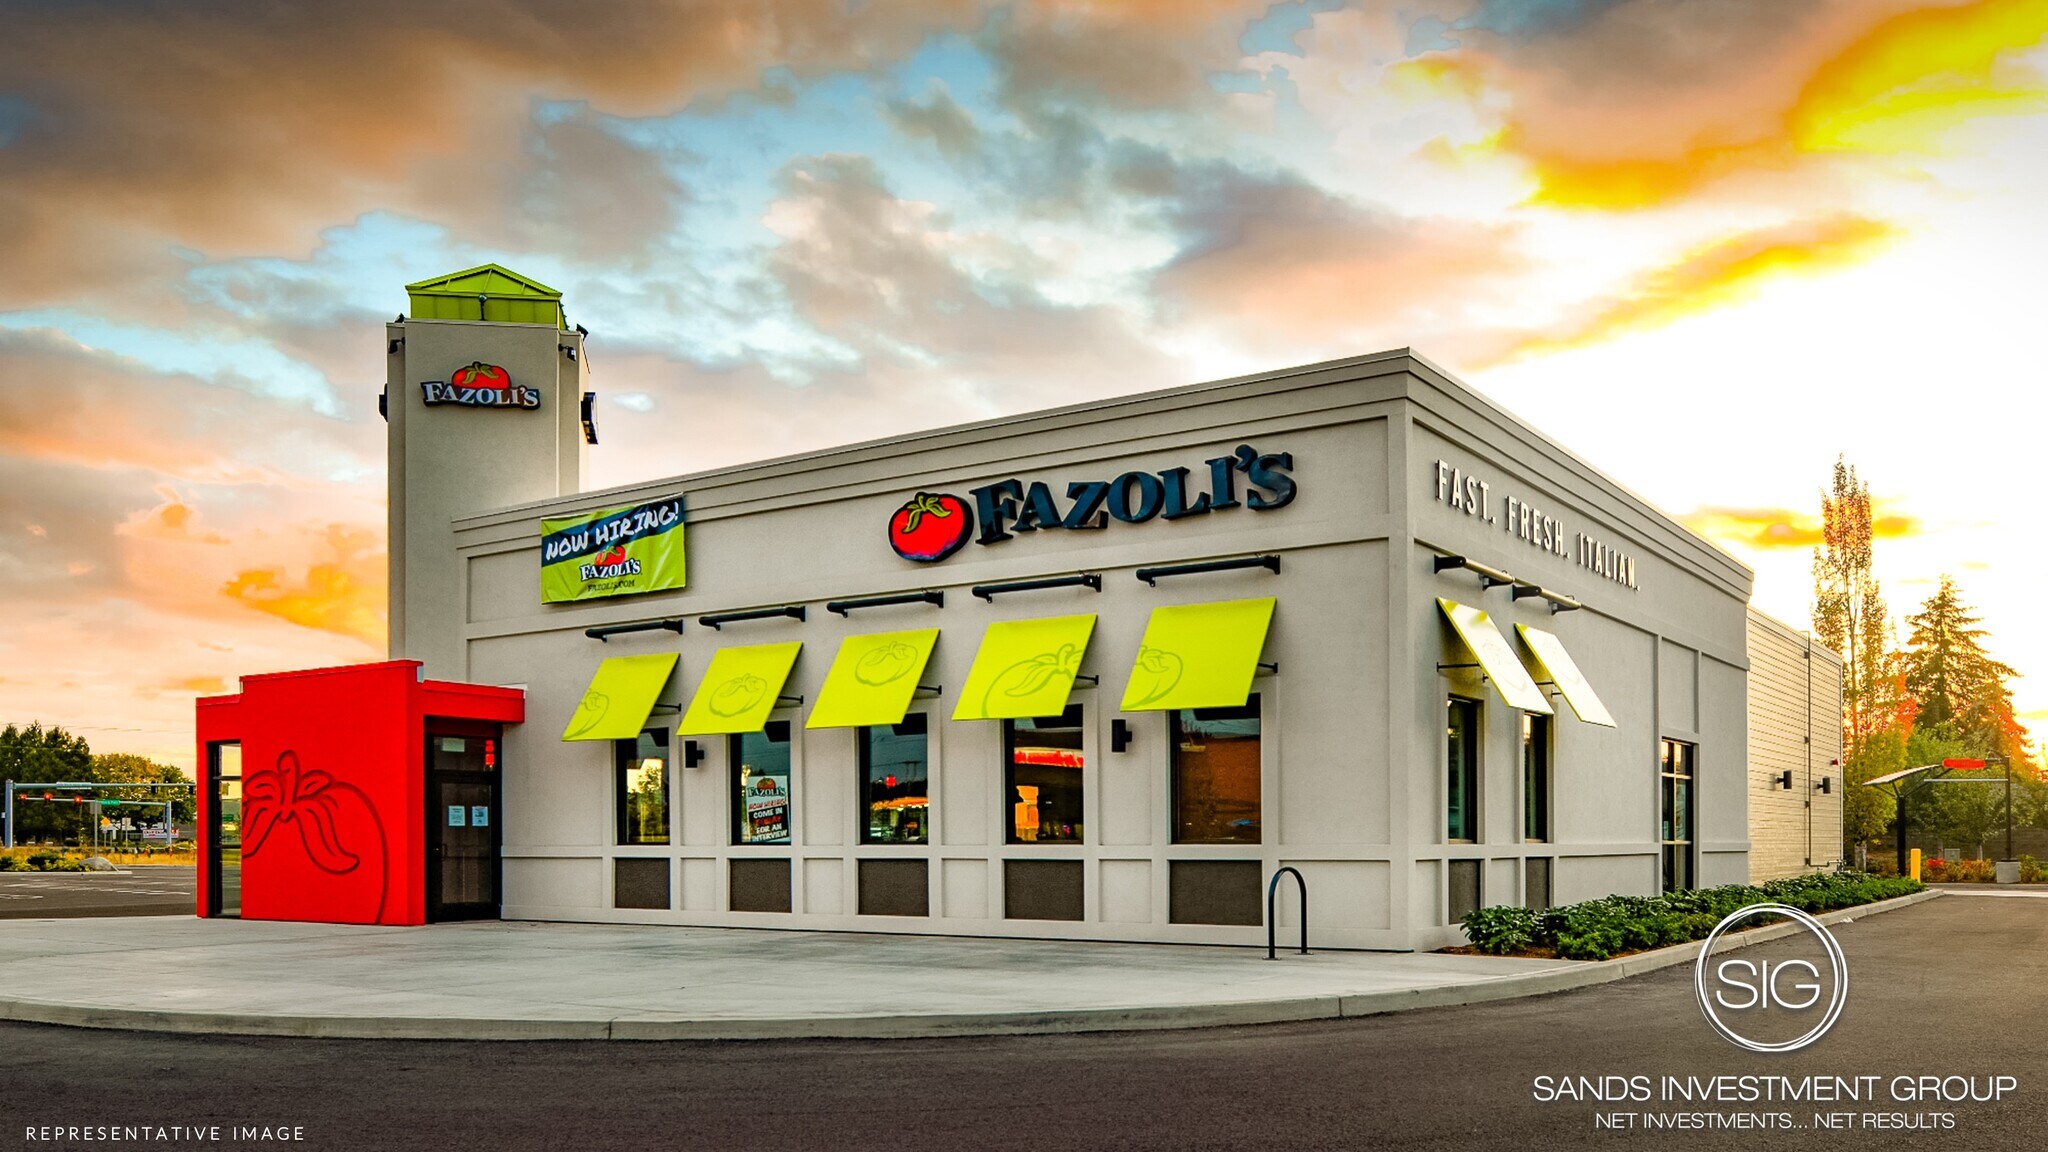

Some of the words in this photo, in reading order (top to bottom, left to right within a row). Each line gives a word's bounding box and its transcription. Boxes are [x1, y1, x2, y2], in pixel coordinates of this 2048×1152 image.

[421, 382, 540, 409] FAZOLI'S
[969, 443, 1298, 545] FAZOLI'S
[545, 530, 589, 561] NOW
[595, 501, 679, 545] HIRING!
[1434, 459, 1497, 525] FAST.
[1505, 495, 1571, 560] FRESH.
[1576, 531, 1641, 592] ITALIAN.
[580, 558, 642, 581] FAZOLI'S
[747, 787, 786, 797] FAZOLI'S
[753, 809, 773, 819] COME
[775, 807, 783, 815] IN
[756, 826, 770, 834] FOR
[772, 823, 782, 832] AN
